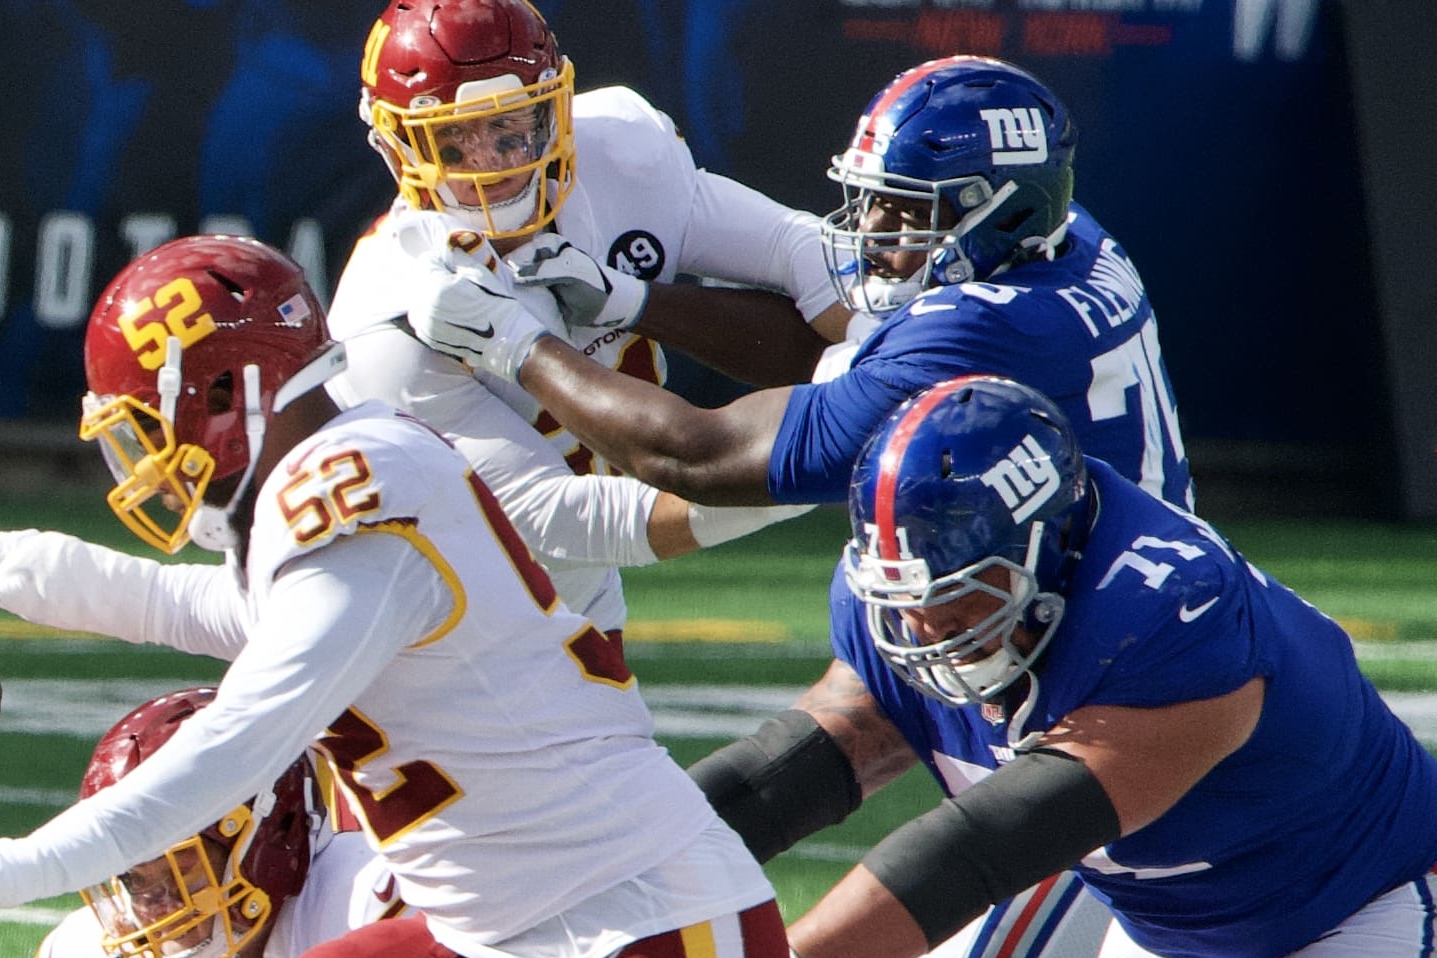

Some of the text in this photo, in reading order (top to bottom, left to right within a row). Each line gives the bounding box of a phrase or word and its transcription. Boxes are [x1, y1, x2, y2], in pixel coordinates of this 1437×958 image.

[614, 236, 660, 276] 49
[117, 277, 218, 371] 52
[277, 449, 381, 546] 52
[864, 522, 913, 560] 71
